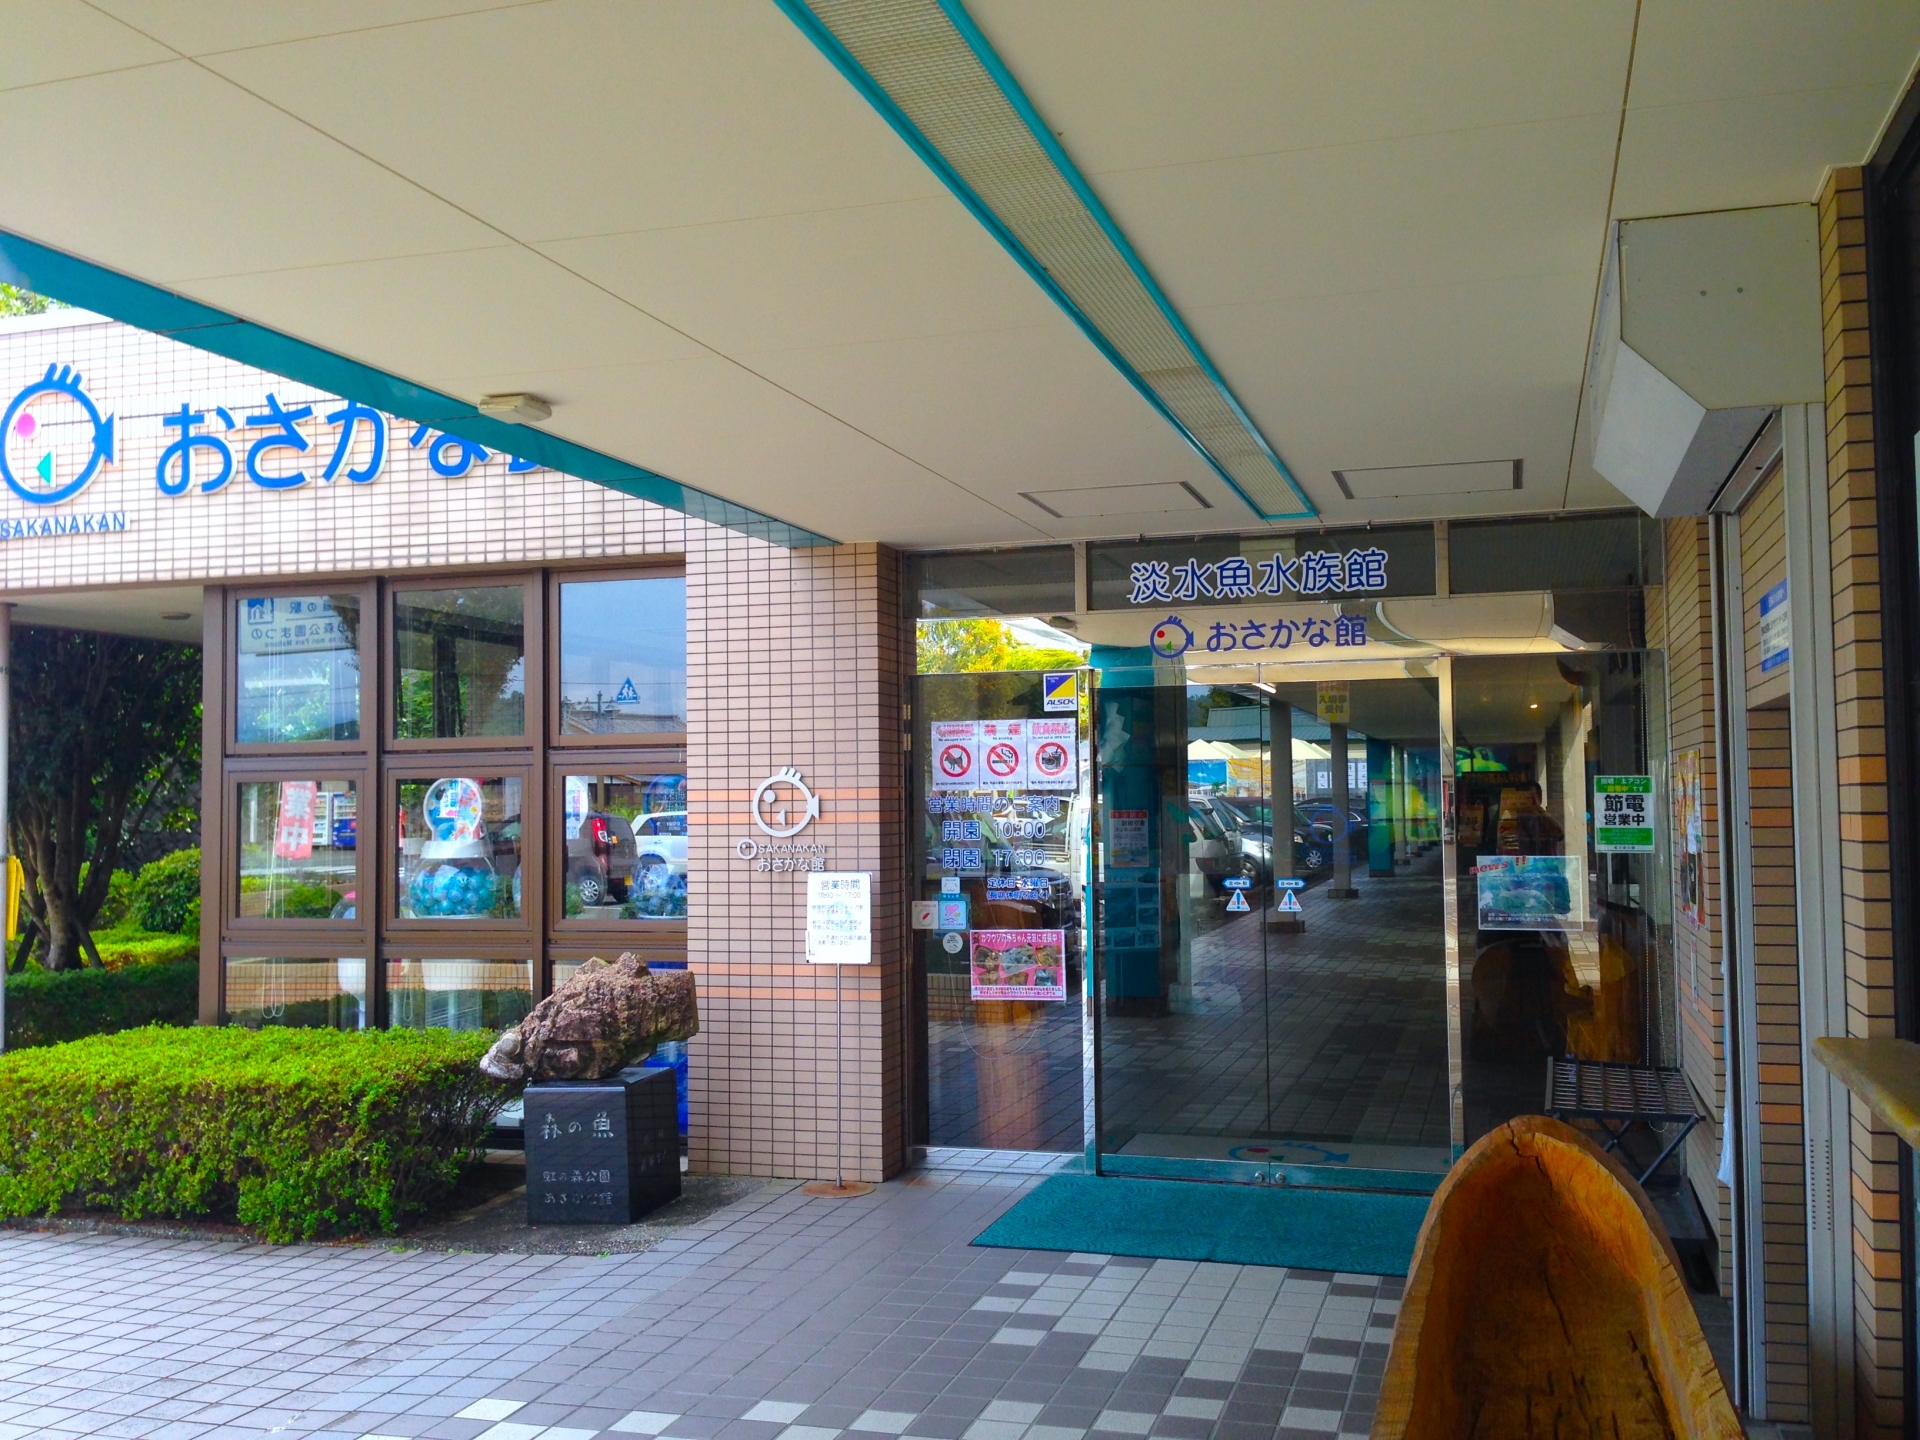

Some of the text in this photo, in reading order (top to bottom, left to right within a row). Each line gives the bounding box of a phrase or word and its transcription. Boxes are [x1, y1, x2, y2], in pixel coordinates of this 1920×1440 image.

[156, 392, 541, 497] おさかな
[1129, 547, 1388, 605] 淡水魚水族館
[1206, 614, 1368, 653] おさかな館
[927, 795, 1060, 814] 営業時間のご案内
[1603, 794, 1645, 812] 節電
[1603, 813, 1645, 826] 営業中
[942, 820, 1046, 842] 開園 10:00
[756, 856, 826, 873] おさかな館
[942, 848, 1046, 869] 閉園 17:00
[1468, 859, 1509, 875] news
[820, 878, 861, 891] 営業時間
[986, 876, 1050, 889] 定休日 水曜日
[538, 1112, 614, 1140] 森の魚
[542, 1169, 611, 1183] 虹の森公園
